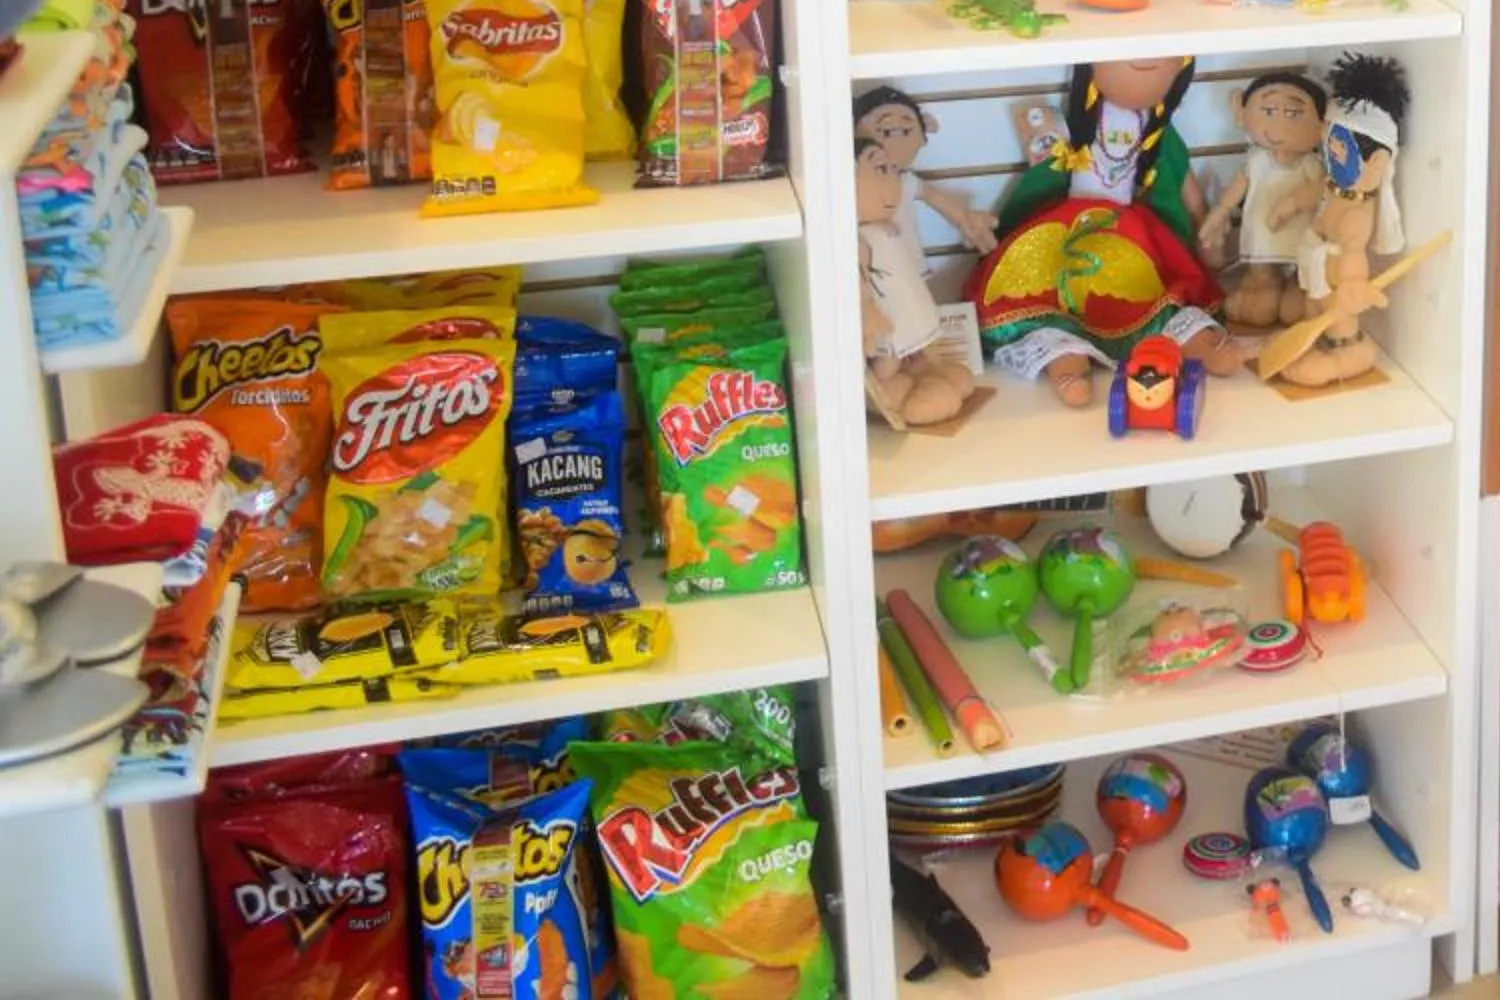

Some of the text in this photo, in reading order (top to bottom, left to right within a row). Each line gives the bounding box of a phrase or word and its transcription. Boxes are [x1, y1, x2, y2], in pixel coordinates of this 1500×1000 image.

[442, 13, 563, 46] Sabritas
[175, 326, 323, 414] Cheetos
[333, 366, 499, 472] Fritos
[659, 370, 787, 468] Ruffles
[527, 454, 604, 490] KACANG
[417, 820, 577, 930] Chtos
[597, 765, 801, 905] Ruffles
[740, 839, 813, 882] QUESO
[235, 871, 387, 925] Doritos
